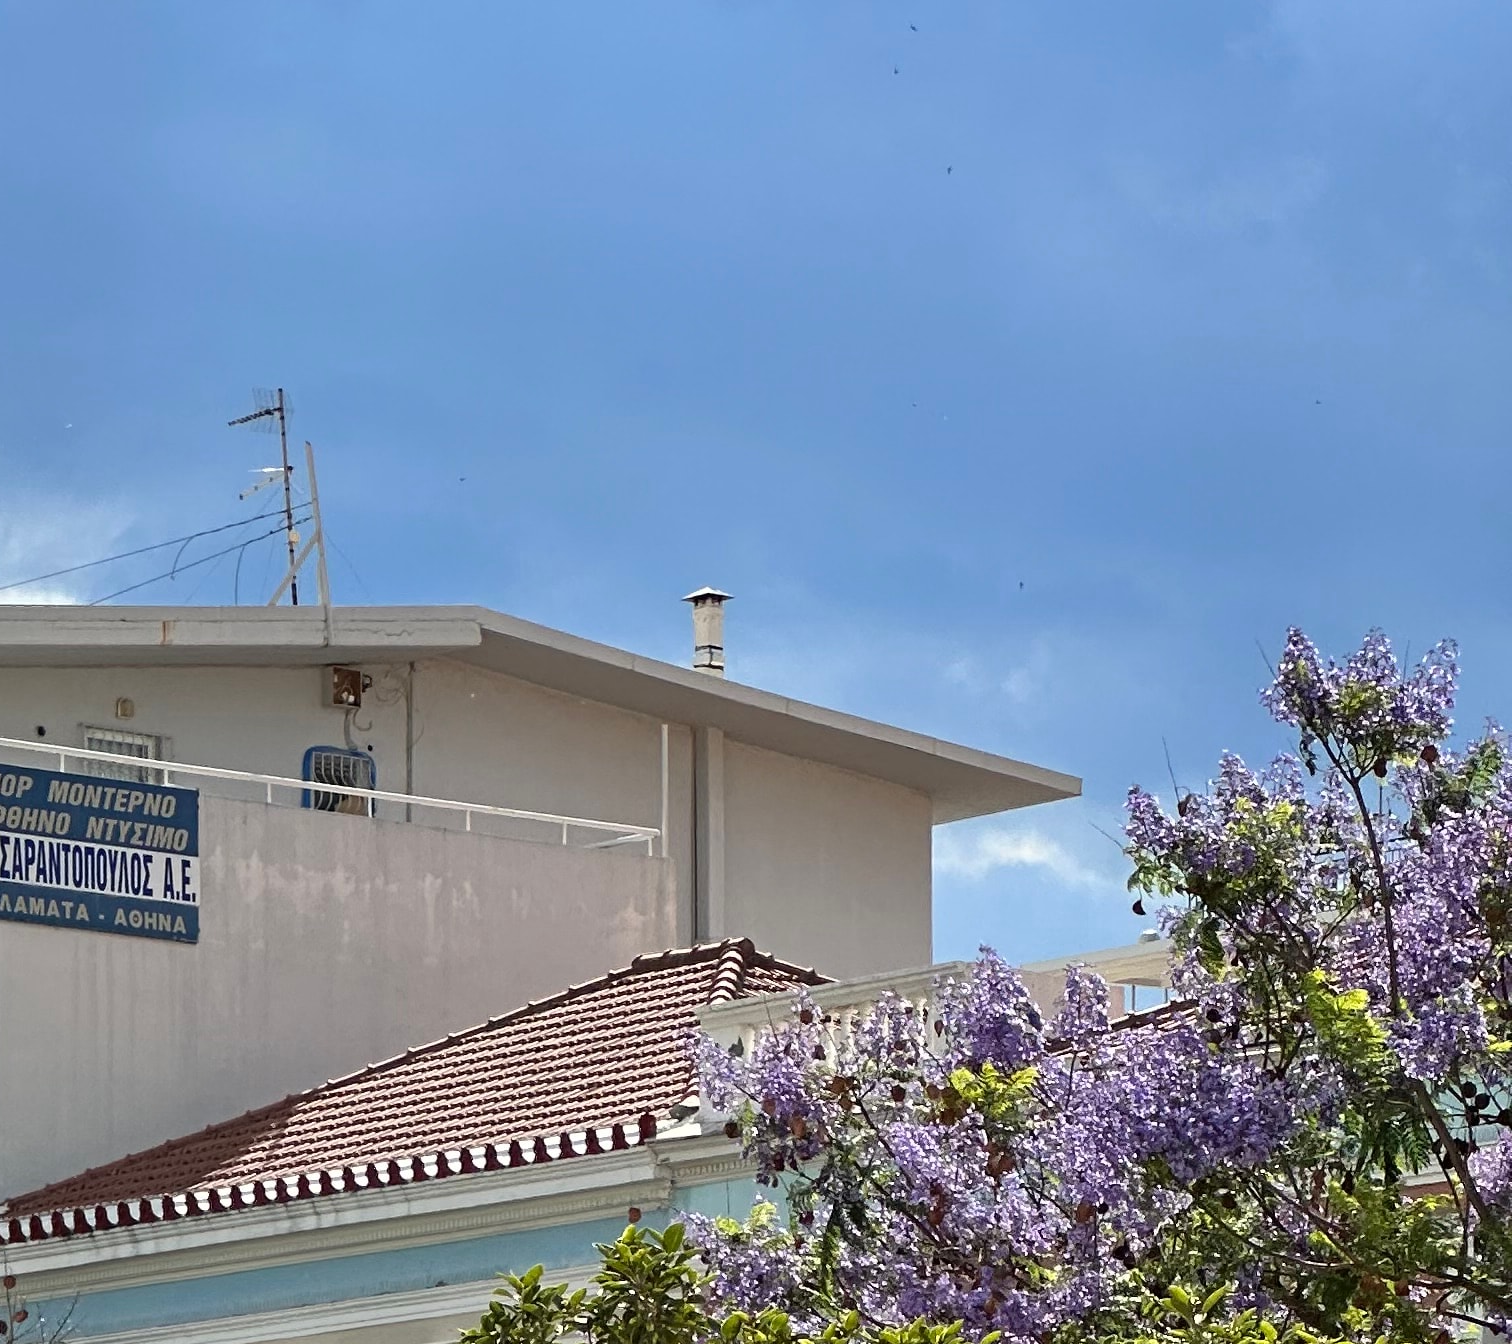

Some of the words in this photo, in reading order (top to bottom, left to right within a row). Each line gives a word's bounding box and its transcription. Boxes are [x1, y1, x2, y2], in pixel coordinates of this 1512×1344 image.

[47, 779, 177, 819] ΜΟΝΤΕΡΝΟ
[85, 816, 189, 852] ΝΤΥΣΙΜΟ
[0, 835, 154, 898] ΣΑΡΑΝΤΟΠΟΥΛΟΣ
[163, 857, 197, 903] Α.Ε.
[114, 908, 187, 934] ΑΘΗΝΑ
